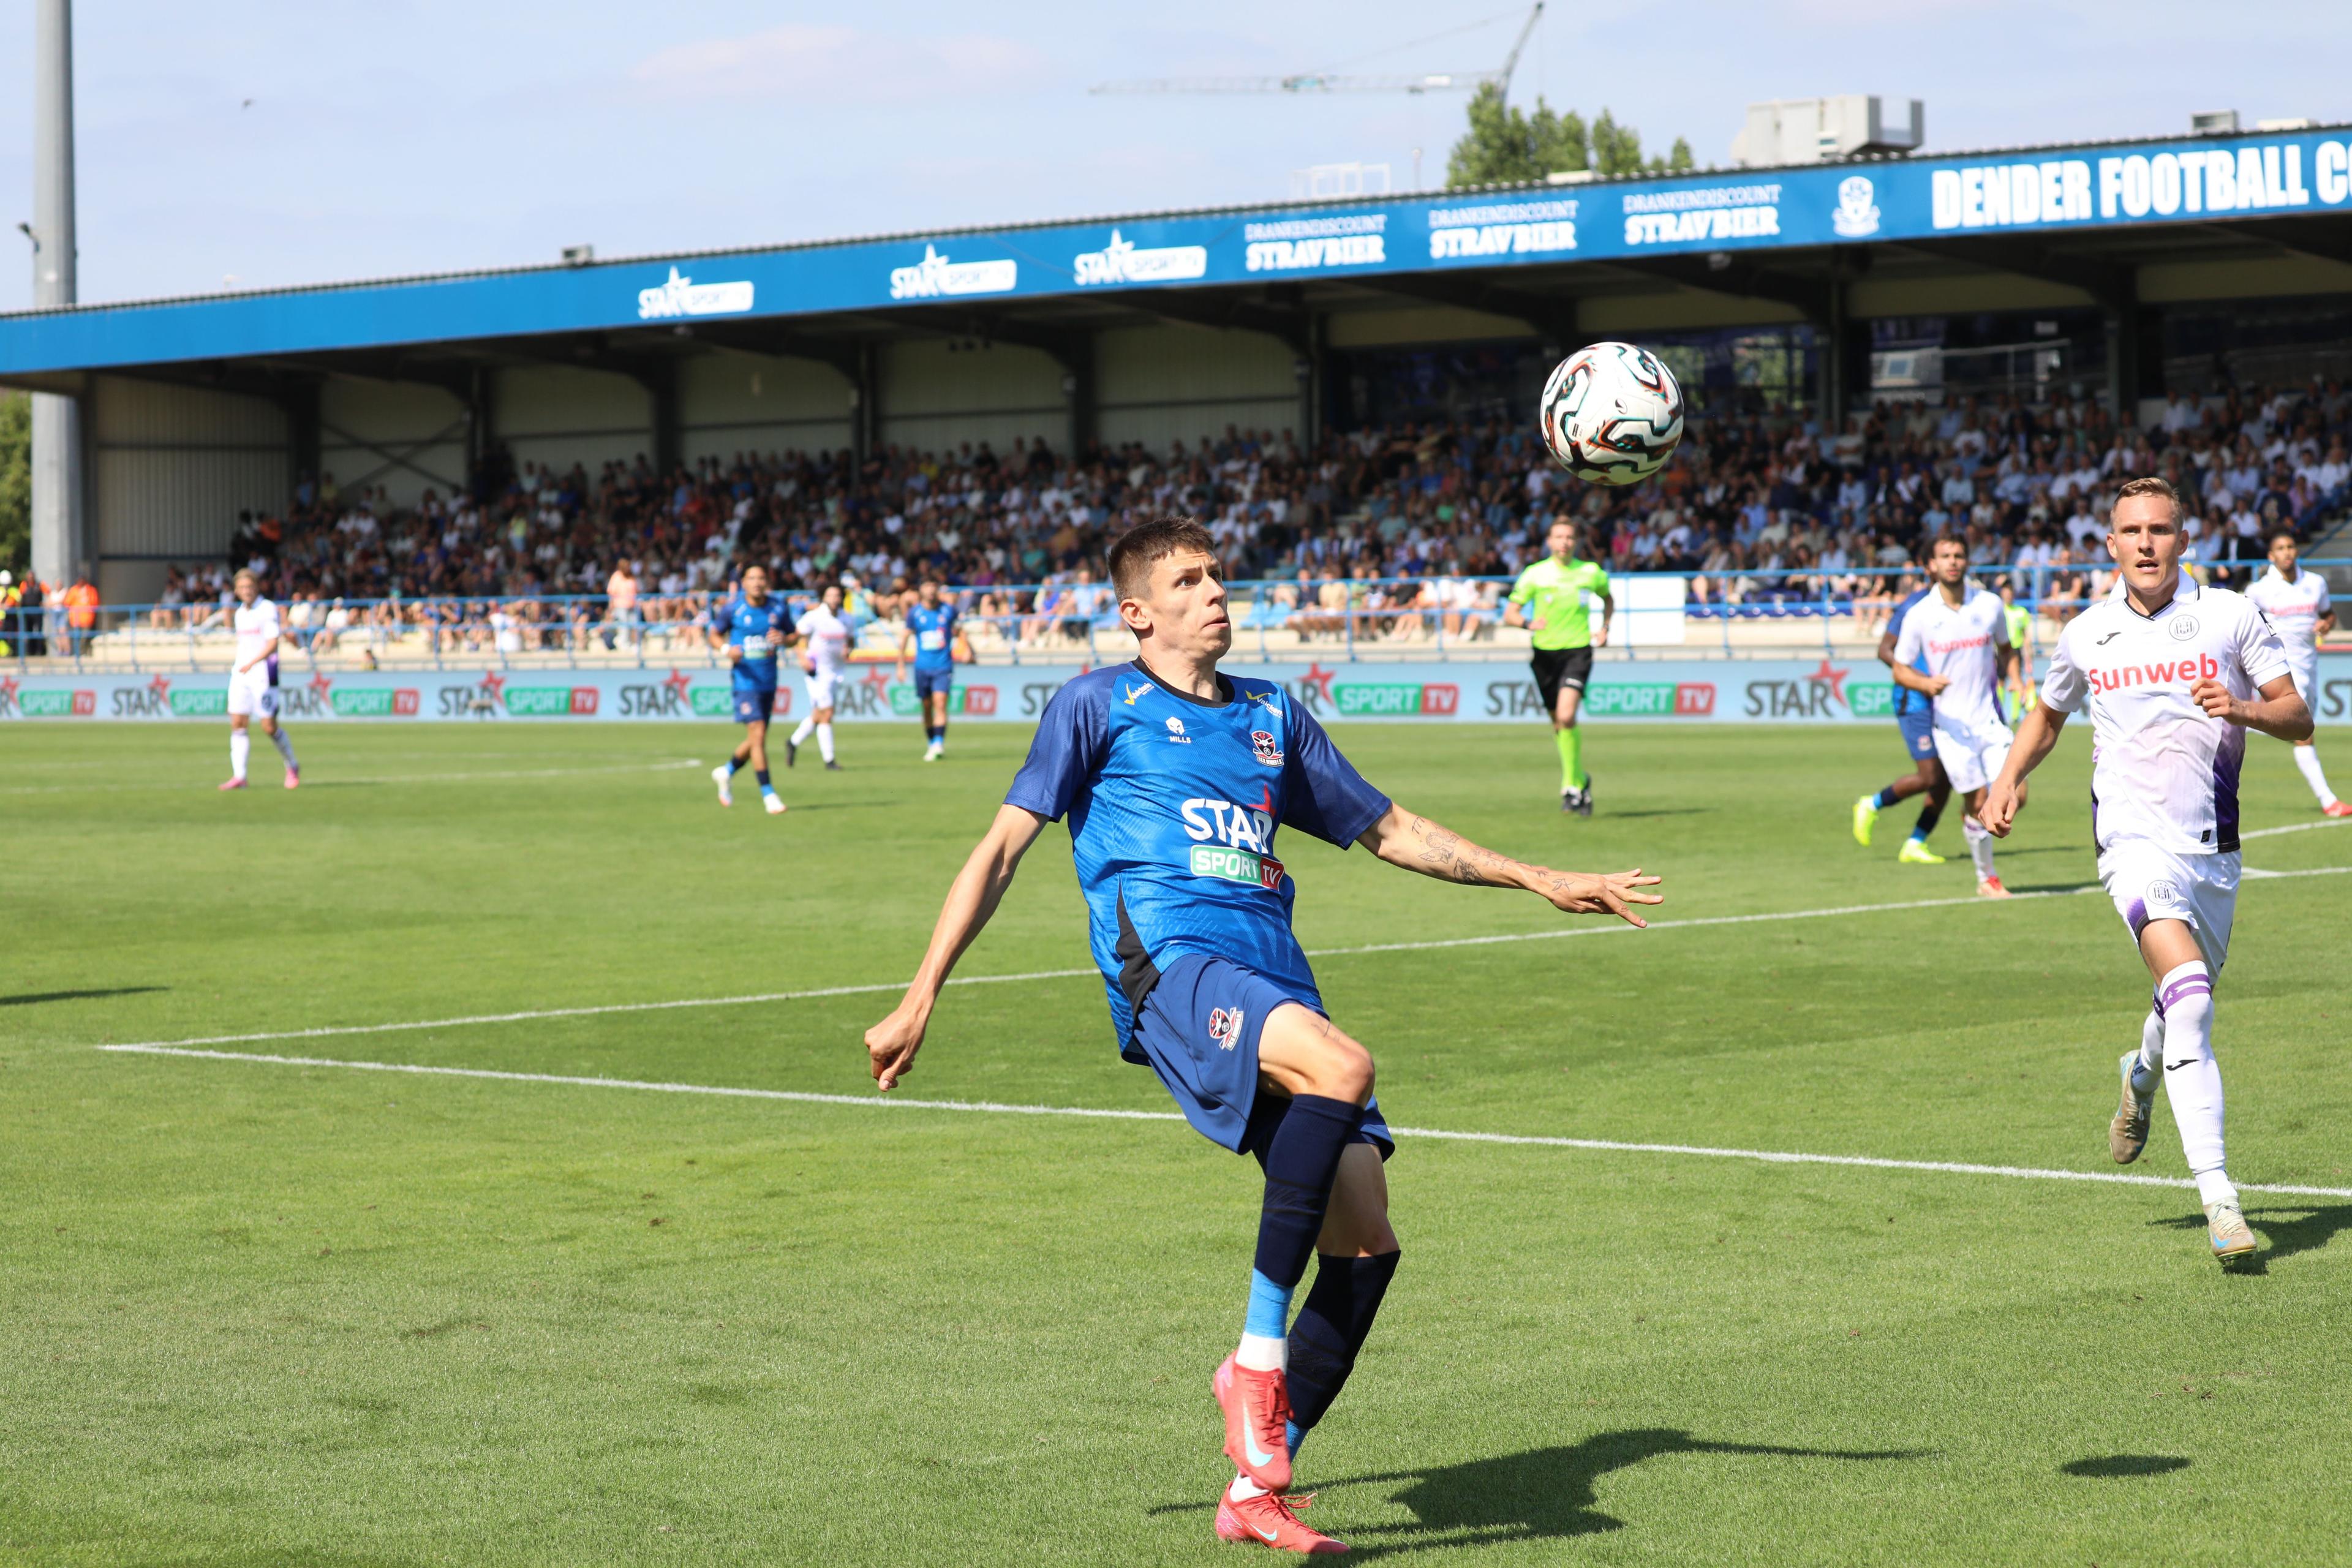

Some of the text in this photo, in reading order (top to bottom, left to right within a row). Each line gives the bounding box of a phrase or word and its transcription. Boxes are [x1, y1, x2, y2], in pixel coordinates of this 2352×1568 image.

[1623, 185, 1782, 214] DRANKENDISCOUNT
[1932, 140, 2352, 230] DENDER FOOTBALL C
[1428, 200, 1578, 228] DRANKENDISCOUNT
[1624, 206, 1781, 245] STRAVBIER
[1246, 235, 1385, 271] STRAVBIER
[1430, 221, 1577, 259] STRAVBIER
[890, 264, 940, 300] STAR
[1074, 248, 1125, 286] STAR
[2089, 653, 2218, 696] Sunweb
[21, 693, 70, 712] SPORT
[112, 687, 227, 716] STAR SPORT
[280, 687, 324, 716] TAR
[333, 692, 392, 712] SPORT
[508, 690, 568, 712] SPORT
[573, 692, 595, 710] TV
[618, 684, 680, 716] STAR
[696, 690, 733, 711] SPO
[832, 682, 880, 715] TAR
[1341, 687, 1418, 712] SPORT
[1427, 687, 1455, 710] TV
[1485, 681, 1711, 716] STA SPORT TV
[1744, 680, 1833, 717] STAR
[1181, 798, 1273, 854] STAR
[1195, 850, 1281, 884] SPORT TV
